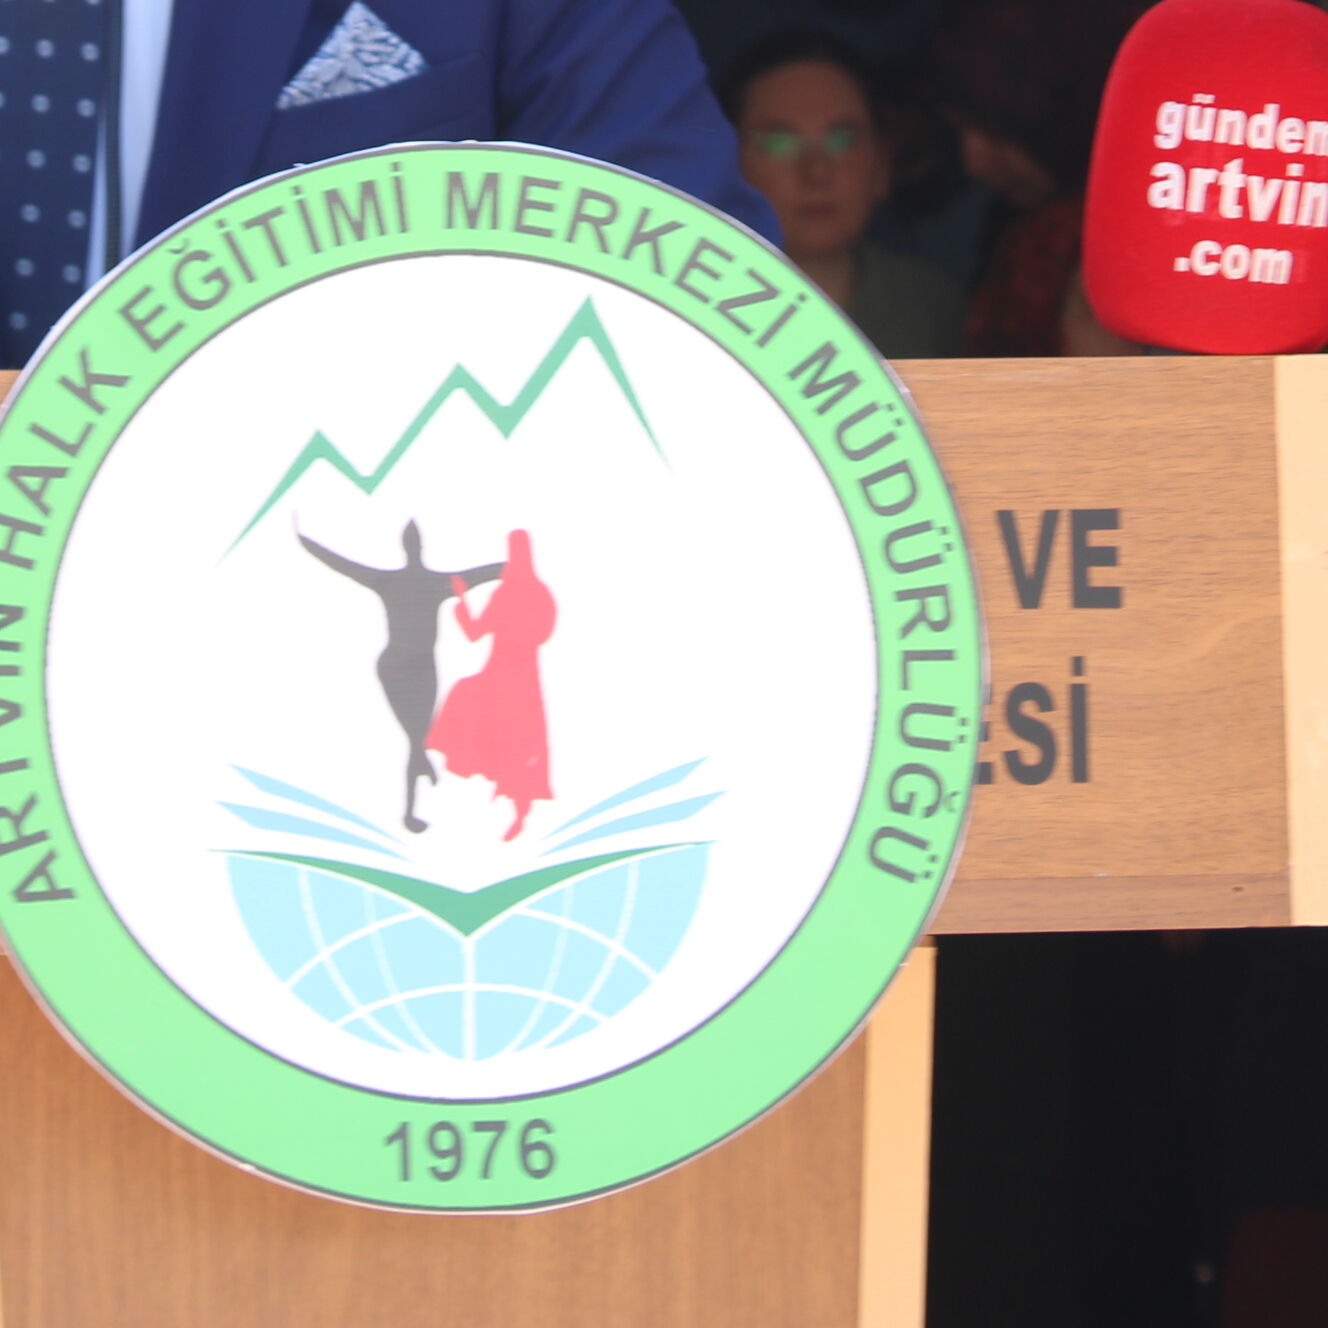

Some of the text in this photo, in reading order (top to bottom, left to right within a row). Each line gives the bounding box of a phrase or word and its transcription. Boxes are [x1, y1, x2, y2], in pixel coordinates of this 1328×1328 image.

[1173, 239, 1294, 285] .com
[117, 161, 410, 353] EĞİTİMİ
[446, 169, 810, 350] MERKEZİ
[786, 340, 968, 886] MÜDÜRLÜĞÜ
[997, 508, 1123, 610] VE
[383, 1118, 557, 1182] 1976
